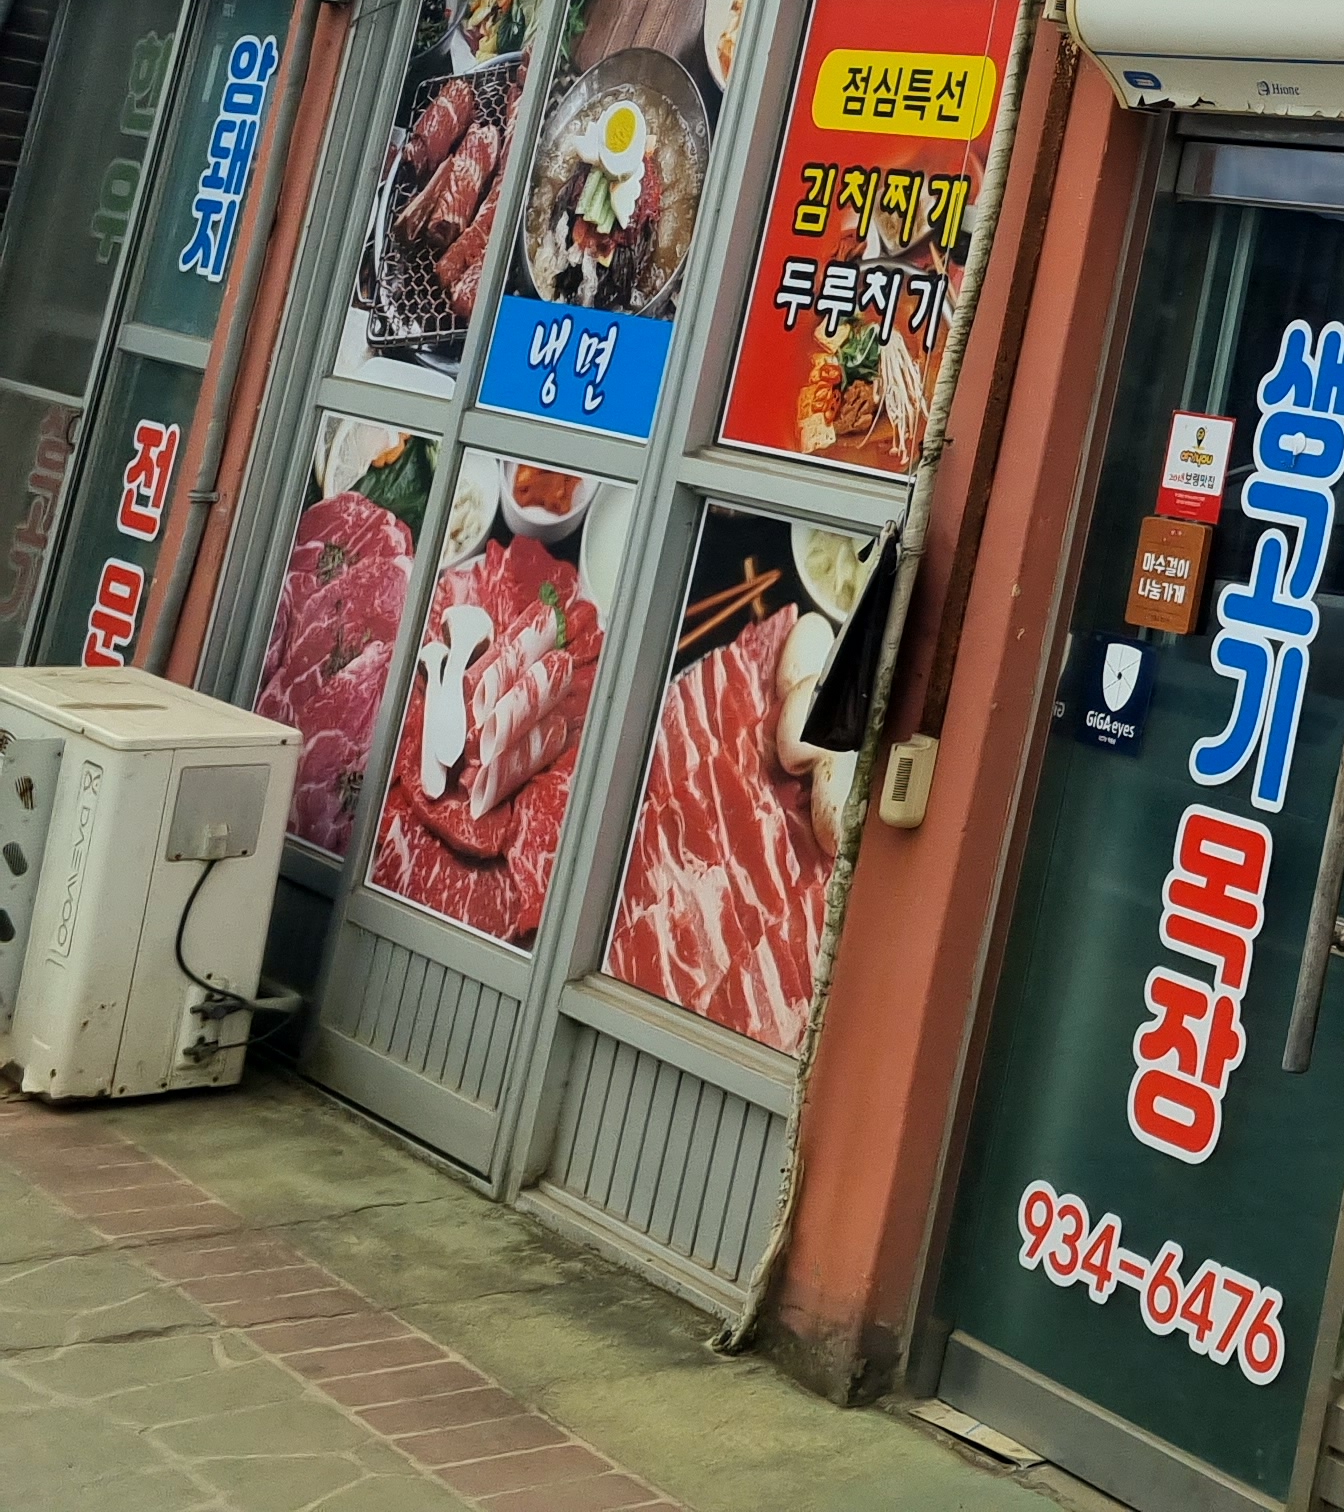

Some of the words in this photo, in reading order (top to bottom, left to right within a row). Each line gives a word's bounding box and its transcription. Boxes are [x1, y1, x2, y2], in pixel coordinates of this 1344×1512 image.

[842, 65, 969, 122] 점심특선
[181, 38, 277, 279] 암돼지
[775, 259, 947, 350] 두루치기
[530, 318, 618, 410] 냉면
[1137, 577, 1186, 604] 나눔가게
[1142, 552, 1191, 579] 마수걸이
[1018, 1182, 1283, 1386] 934-6476
